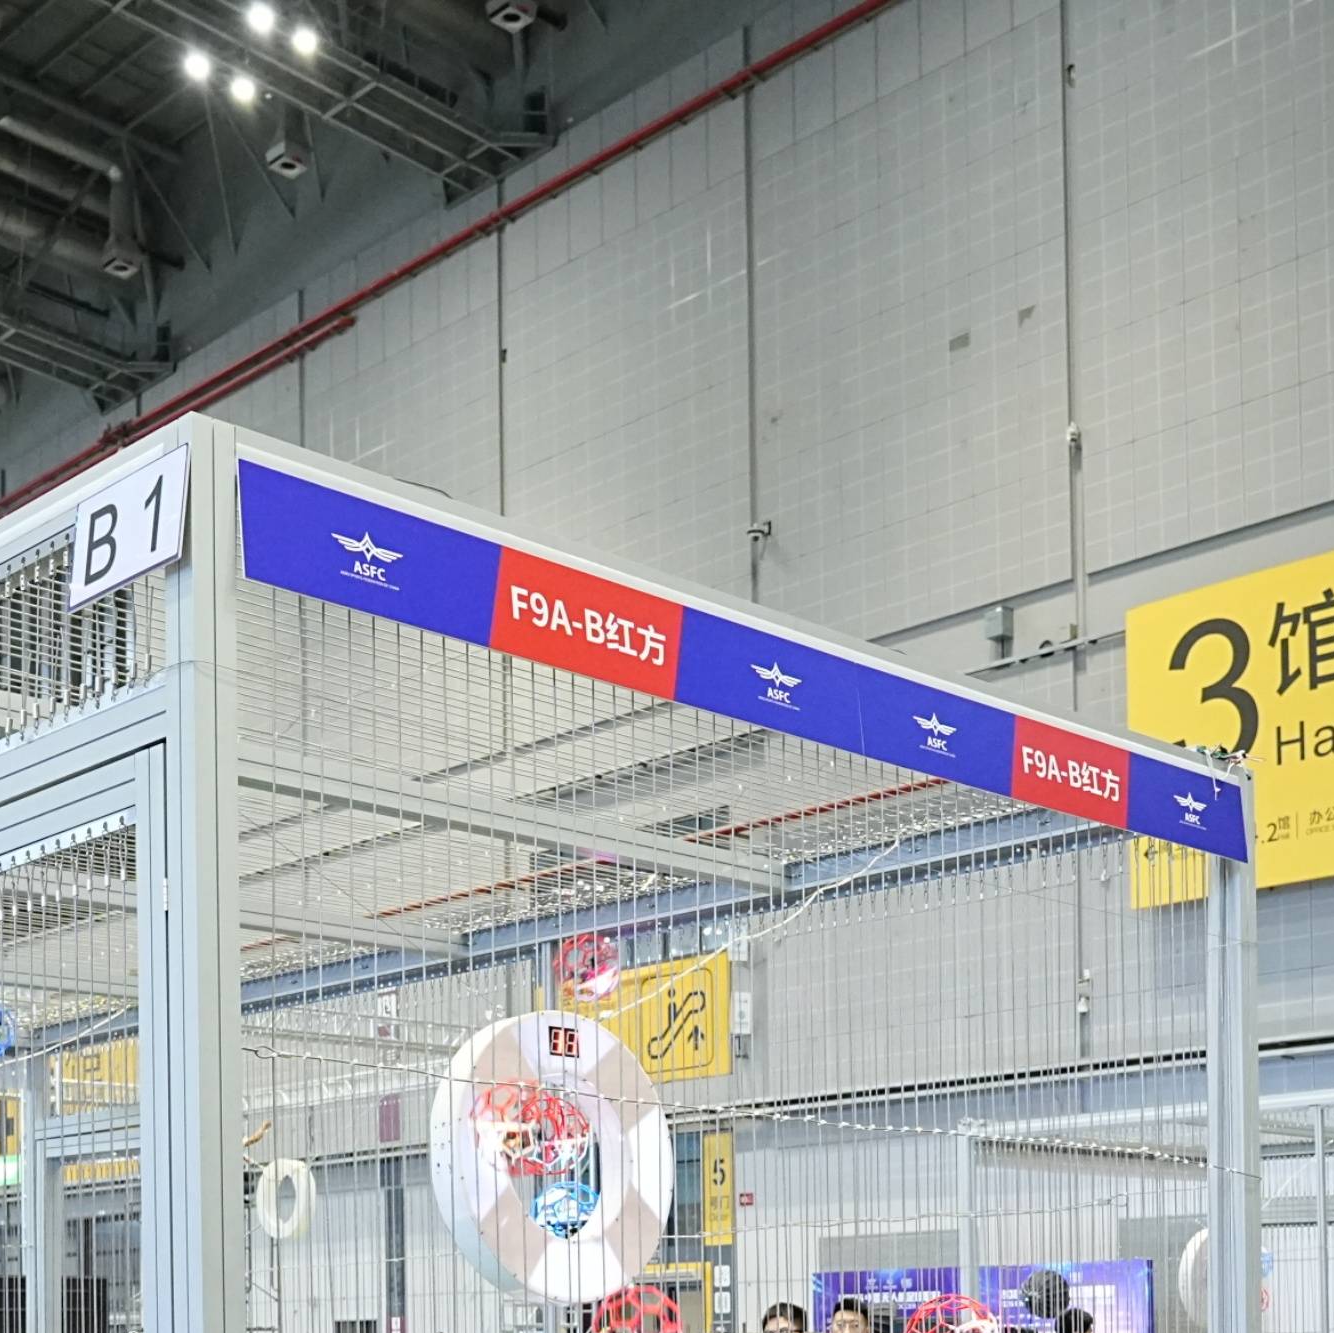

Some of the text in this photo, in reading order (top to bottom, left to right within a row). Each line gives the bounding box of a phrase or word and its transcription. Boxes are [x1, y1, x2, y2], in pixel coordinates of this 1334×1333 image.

[84, 474, 164, 587] B 1
[353, 560, 387, 582] ASFC
[510, 584, 666, 667] F9A-B红方
[767, 687, 791, 704] ASFC
[1168, 617, 1259, 755] 3
[927, 736, 948, 751] ASFC
[1021, 745, 1120, 802] F9A-B红方
